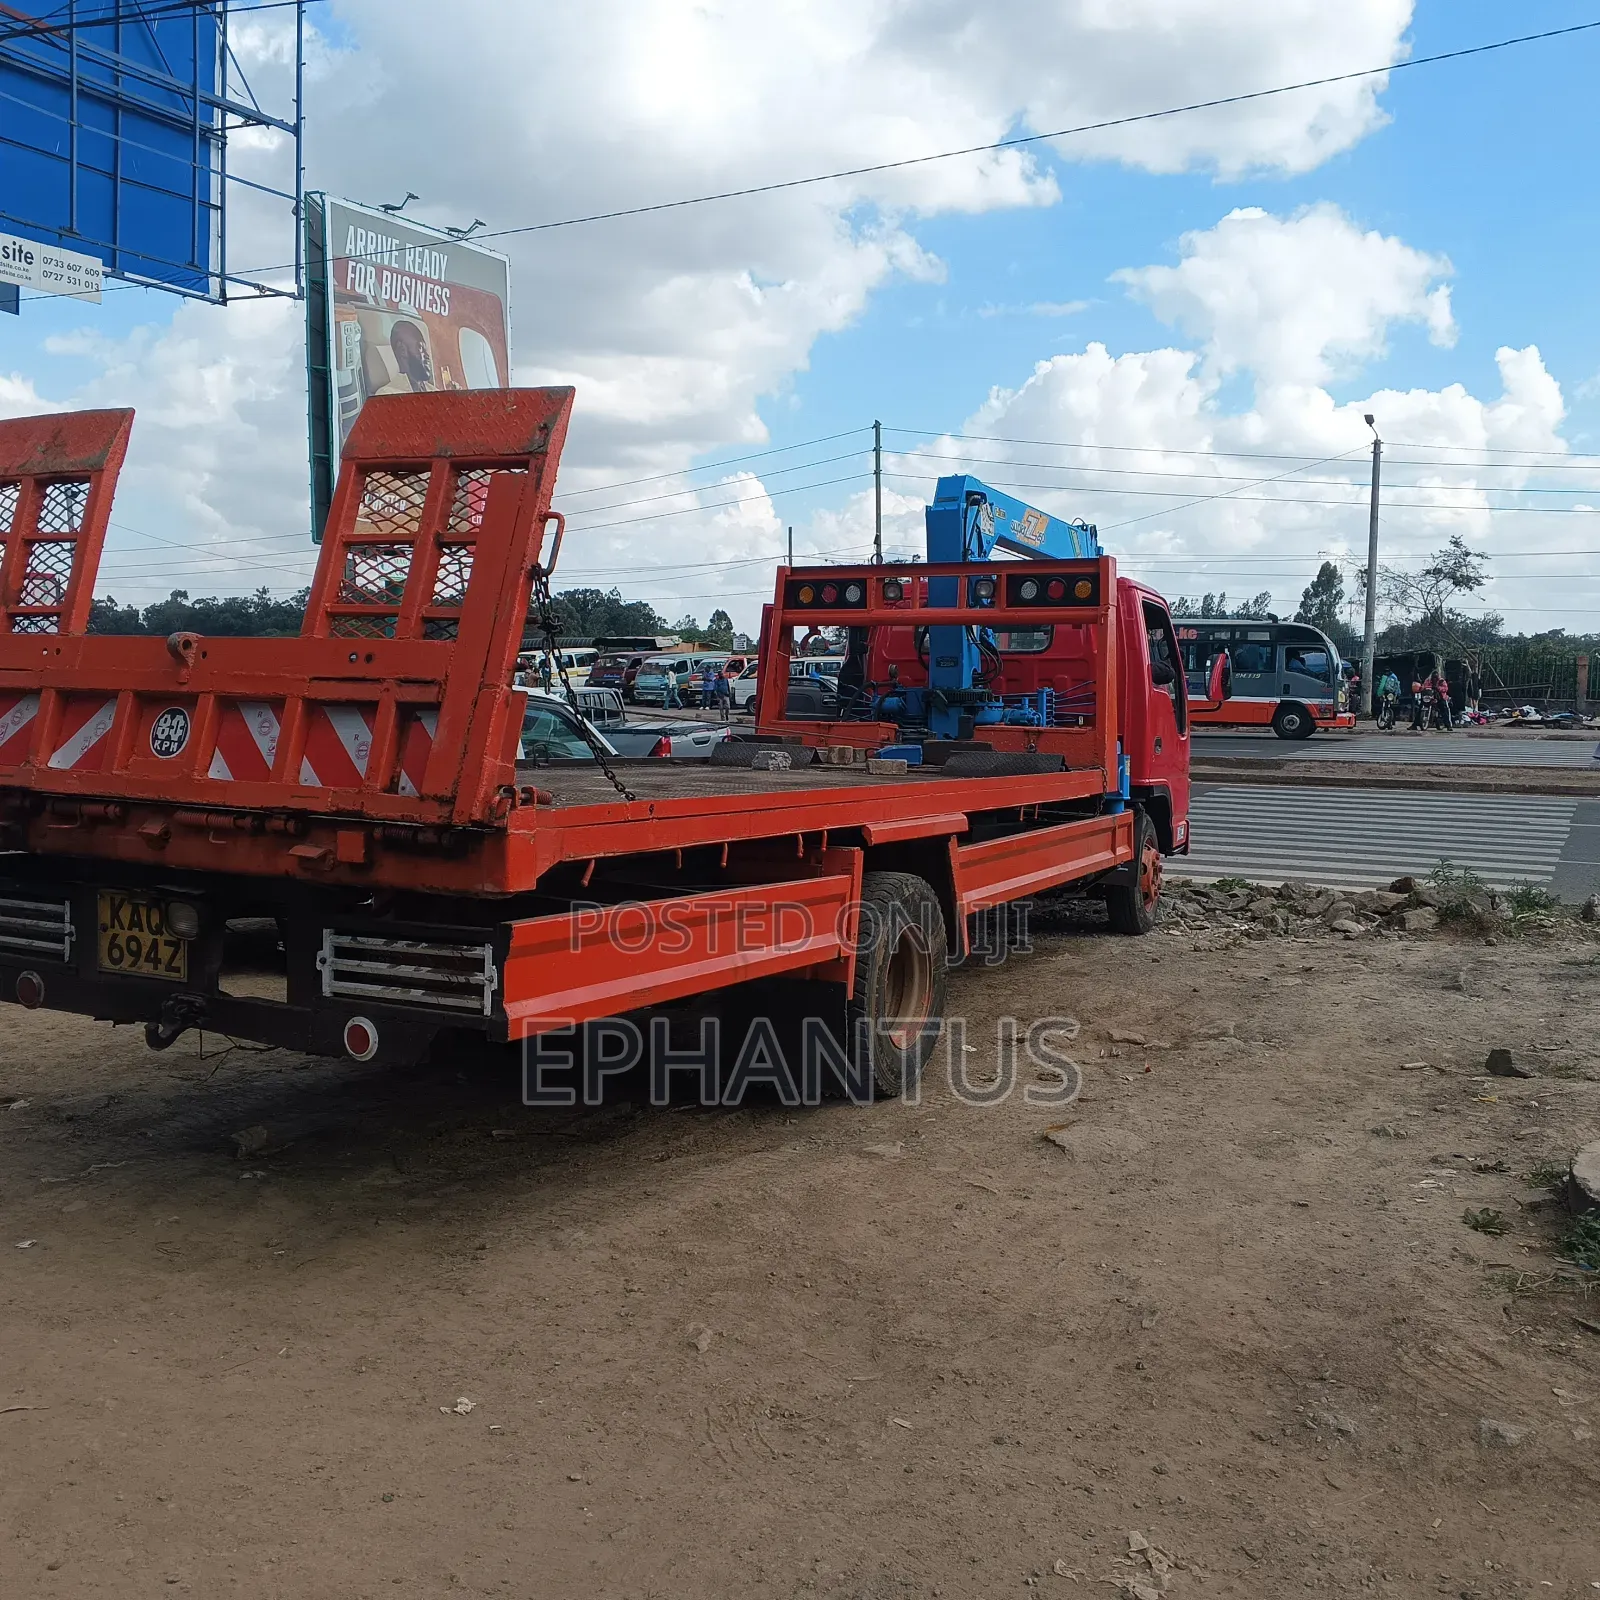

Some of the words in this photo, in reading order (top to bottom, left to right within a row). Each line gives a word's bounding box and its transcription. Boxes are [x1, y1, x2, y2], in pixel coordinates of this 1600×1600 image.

[1, 240, 34, 266] site
[42, 256, 65, 269] 0733
[66, 263, 82, 273] 607
[84, 267, 100, 278] 609
[345, 225, 400, 268] ARRIVE
[404, 242, 448, 282] READY
[42, 270, 64, 282] 0727
[66, 276, 81, 287] 531
[84, 280, 100, 292] 013
[346, 260, 376, 297] FOR
[382, 269, 451, 317] BUSINESS
[153, 740, 178, 752] KPH
[110, 896, 165, 937] KAQ
[107, 933, 182, 973] 694Z
